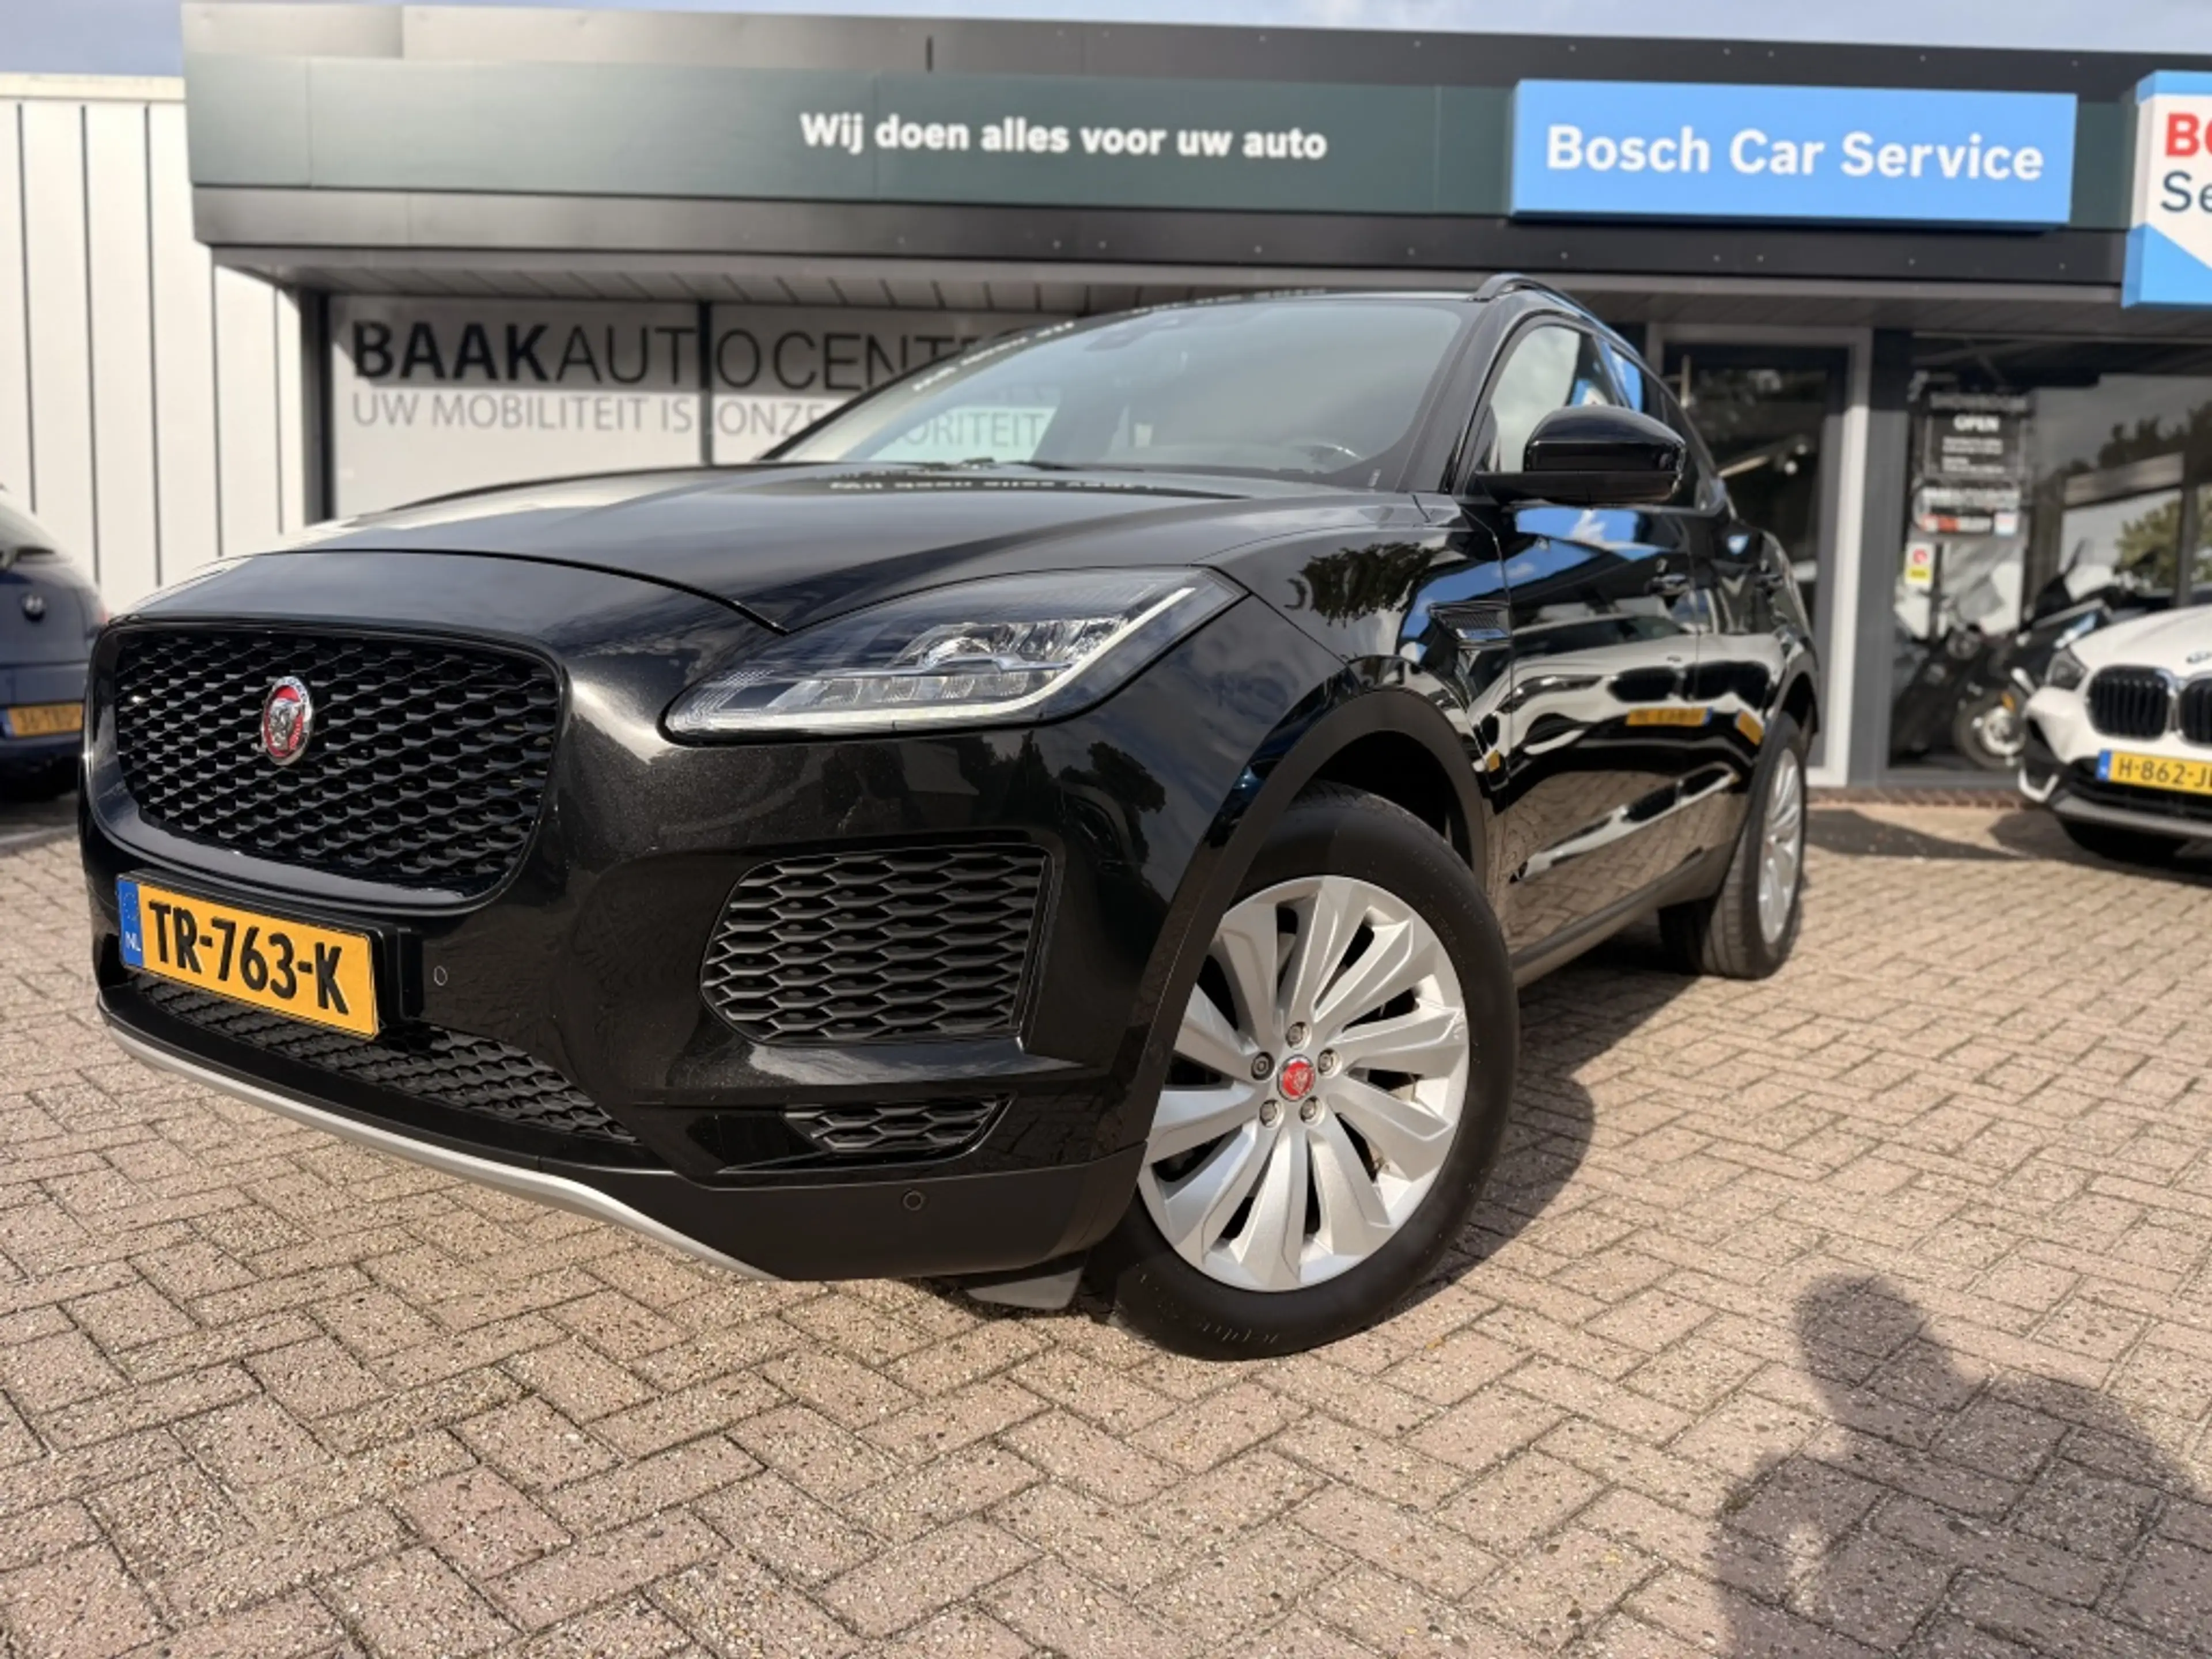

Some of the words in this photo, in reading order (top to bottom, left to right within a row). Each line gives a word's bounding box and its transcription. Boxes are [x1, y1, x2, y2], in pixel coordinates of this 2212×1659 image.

[800, 112, 863, 156] Wij
[874, 113, 969, 150] doen
[980, 116, 1070, 153] alles
[1080, 127, 1167, 156] voor
[1177, 130, 1233, 157] uw
[1243, 128, 1328, 160] auto
[1547, 124, 1710, 172] Bosch
[1729, 128, 1826, 175] Car
[1840, 131, 2044, 181] Service
[2165, 111, 2212, 158] B
[353, 393, 421, 427] UW
[431, 394, 650, 431] MOBILITEIT
[661, 395, 693, 433] IS
[2118, 756, 2212, 789] H-862-J
[124, 930, 142, 952] NL
[149, 899, 349, 1016] TR-763-K
